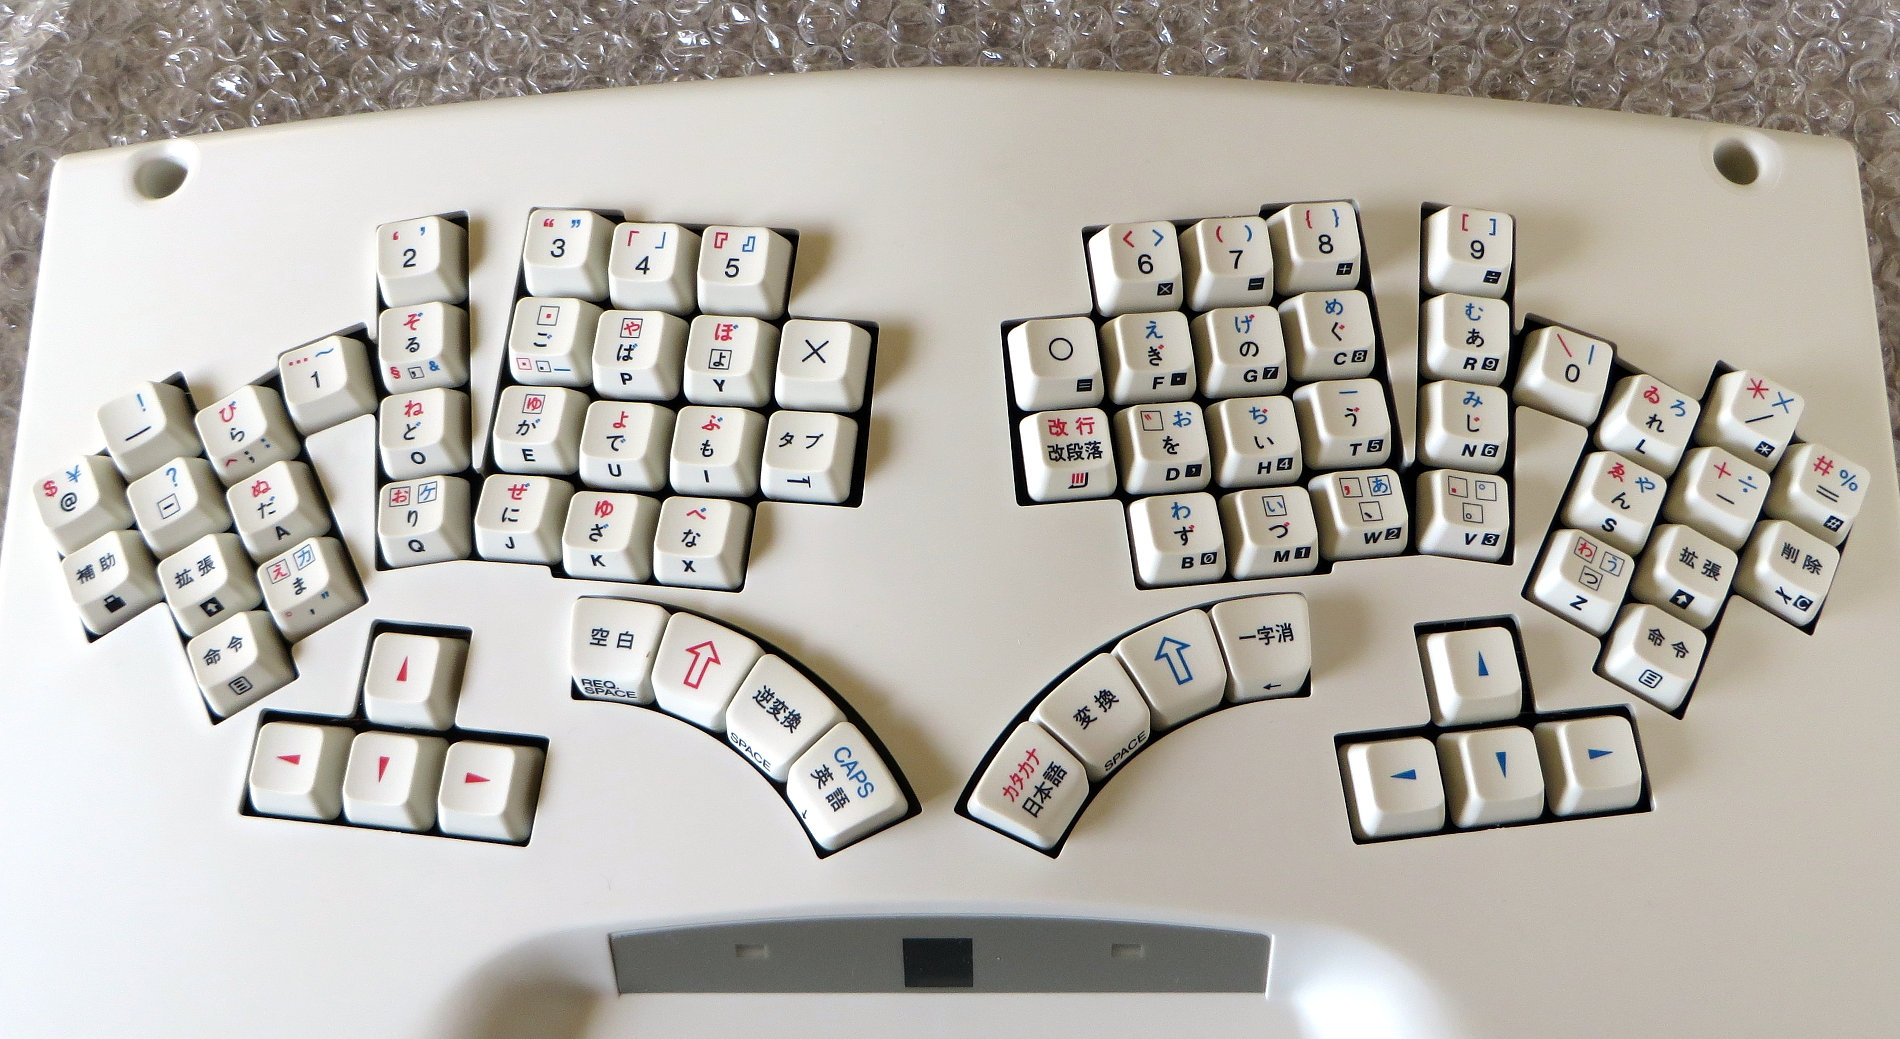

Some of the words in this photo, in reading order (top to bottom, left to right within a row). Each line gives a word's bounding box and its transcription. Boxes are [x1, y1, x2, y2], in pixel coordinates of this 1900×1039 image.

[1305, 209, 1312, 229] {
[1332, 208, 1340, 228] }
[1462, 214, 1469, 231] [
[1489, 219, 1496, 236] ]
[1122, 230, 1134, 248] <
[1152, 229, 1164, 247] >
[1216, 225, 1223, 243] (
[1245, 225, 1252, 242] )
[550, 239, 566, 258] 3
[1318, 234, 1334, 254] 8
[1470, 240, 1484, 259] 9
[403, 248, 416, 267] 2
[635, 256, 650, 275] 4
[1137, 254, 1154, 274] 6
[1229, 250, 1243, 269] 7
[724, 258, 740, 278] 5
[1325, 299, 1344, 316] め
[1465, 303, 1483, 321] む
[403, 312, 423, 330] ぞ
[1146, 321, 1163, 339] え
[1235, 314, 1255, 334] げ
[533, 332, 552, 347] ご
[714, 323, 739, 341] ぼ
[1331, 322, 1345, 341] ぐ
[1466, 328, 1484, 347] あ
[405, 337, 420, 353] る
[617, 344, 638, 361] ば
[1239, 341, 1259, 357] の
[1148, 345, 1164, 366] ぎ
[1333, 353, 1347, 365] C
[1355, 351, 1364, 361] 8
[1463, 357, 1477, 370] R
[1485, 359, 1496, 369] 9
[428, 360, 440, 371] &
[1565, 364, 1580, 383] 0
[310, 372, 320, 389] 1
[620, 373, 632, 385] P
[1153, 377, 1165, 390] F
[1243, 370, 1258, 383] G
[1266, 369, 1276, 378] 7
[712, 379, 725, 392] Y
[136, 393, 146, 413] !
[404, 400, 424, 417] ね
[1463, 391, 1483, 408] み
[1670, 400, 1686, 417] ろ
[219, 401, 237, 422] び
[612, 411, 629, 429] よ
[1172, 410, 1192, 427] お
[1249, 406, 1269, 424] ぢ
[403, 421, 421, 440] ど
[515, 419, 541, 436] が
[1048, 416, 1096, 437] 改行
[1467, 414, 1480, 433] じ
[1645, 414, 1665, 433] れ
[230, 427, 245, 442] ら
[606, 434, 626, 452] で
[778, 432, 824, 449] タブ
[1254, 435, 1274, 449] い
[700, 439, 714, 458] も
[1047, 441, 1103, 462] 改段落
[1163, 436, 1179, 454] を
[1350, 443, 1362, 456] T
[1370, 441, 1380, 451] 5
[1461, 444, 1477, 457] N
[1484, 446, 1496, 456] 6
[1635, 439, 1646, 454] L
[522, 449, 536, 462] E
[608, 464, 622, 477] U
[1166, 468, 1179, 480] D
[1258, 462, 1271, 474] H
[1280, 459, 1290, 469] 4
[1813, 455, 1834, 476] #
[1839, 470, 1858, 492] %
[43, 480, 58, 497] $
[66, 466, 82, 483] ¥
[165, 467, 178, 488] ?
[1635, 476, 1656, 493] や
[252, 478, 271, 497] ぬ
[508, 483, 530, 500] ぜ
[60, 492, 78, 512] @
[257, 496, 275, 519] だ
[595, 500, 614, 518] ゆ
[1611, 492, 1630, 510] ん
[407, 510, 418, 527] り
[501, 507, 520, 523] に
[1171, 502, 1191, 520] わ
[274, 526, 291, 540] A
[588, 523, 609, 542] ざ
[1268, 522, 1290, 538] づ
[1602, 518, 1617, 532] S
[505, 537, 515, 549] J
[681, 529, 700, 548] な
[1173, 525, 1195, 546] ず
[1364, 532, 1382, 544] W
[1465, 533, 1477, 546] V
[1486, 534, 1496, 545] 3
[408, 539, 425, 552] Q
[591, 555, 606, 568] K
[1182, 557, 1194, 569] B
[1273, 551, 1290, 562] M
[1299, 549, 1306, 558] 1
[1679, 546, 1723, 582] 拡張
[1780, 542, 1823, 576] 削除
[76, 551, 117, 584] 補助
[174, 554, 215, 587] 拡張
[681, 560, 696, 573] X
[292, 577, 307, 595] ま
[1569, 595, 1589, 611] Z
[590, 627, 635, 650] 空白
[1238, 622, 1295, 646] 一字消
[203, 634, 244, 665] 命令
[1647, 628, 1690, 660] 命令
[584, 686, 637, 699] SPACE
[752, 685, 802, 734] 逆変換
[1073, 688, 1120, 730] 変換
[729, 731, 772, 772] SPACE
[1104, 730, 1148, 773] SPACE
[833, 746, 875, 799] CAPS
[1002, 748, 1043, 802] カタカナ
[810, 764, 850, 813] 英語
[1022, 761, 1068, 819] 日本語
